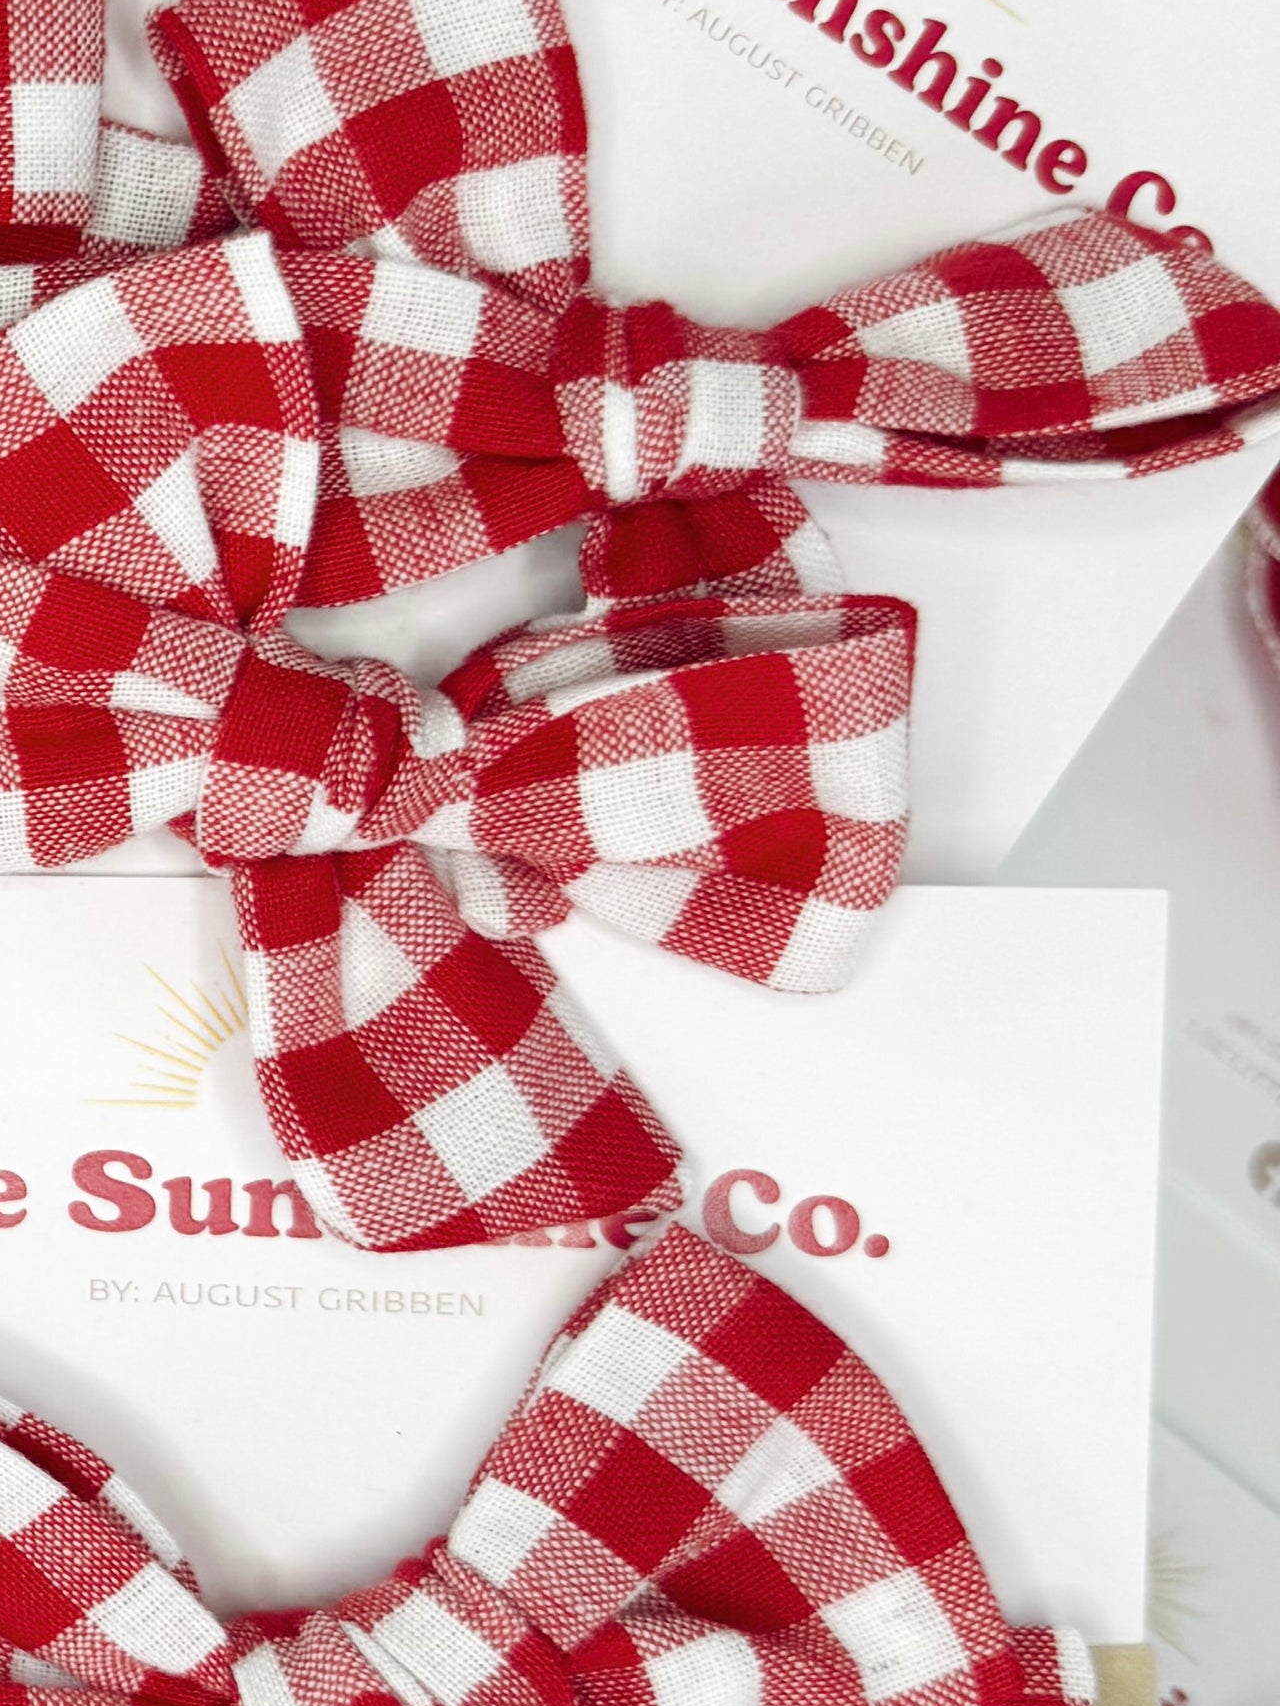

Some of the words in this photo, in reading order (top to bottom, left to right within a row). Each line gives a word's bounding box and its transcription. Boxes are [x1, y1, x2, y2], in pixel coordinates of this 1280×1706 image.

[686, 6, 804, 90] AUGUST
[804, 84, 925, 177] GRIBBEN
[702, 1167, 890, 1260] Co.
[88, 1276, 141, 1304] BY:
[151, 1278, 305, 1311] AUGUST
[317, 1285, 486, 1319] GRIBBEN
